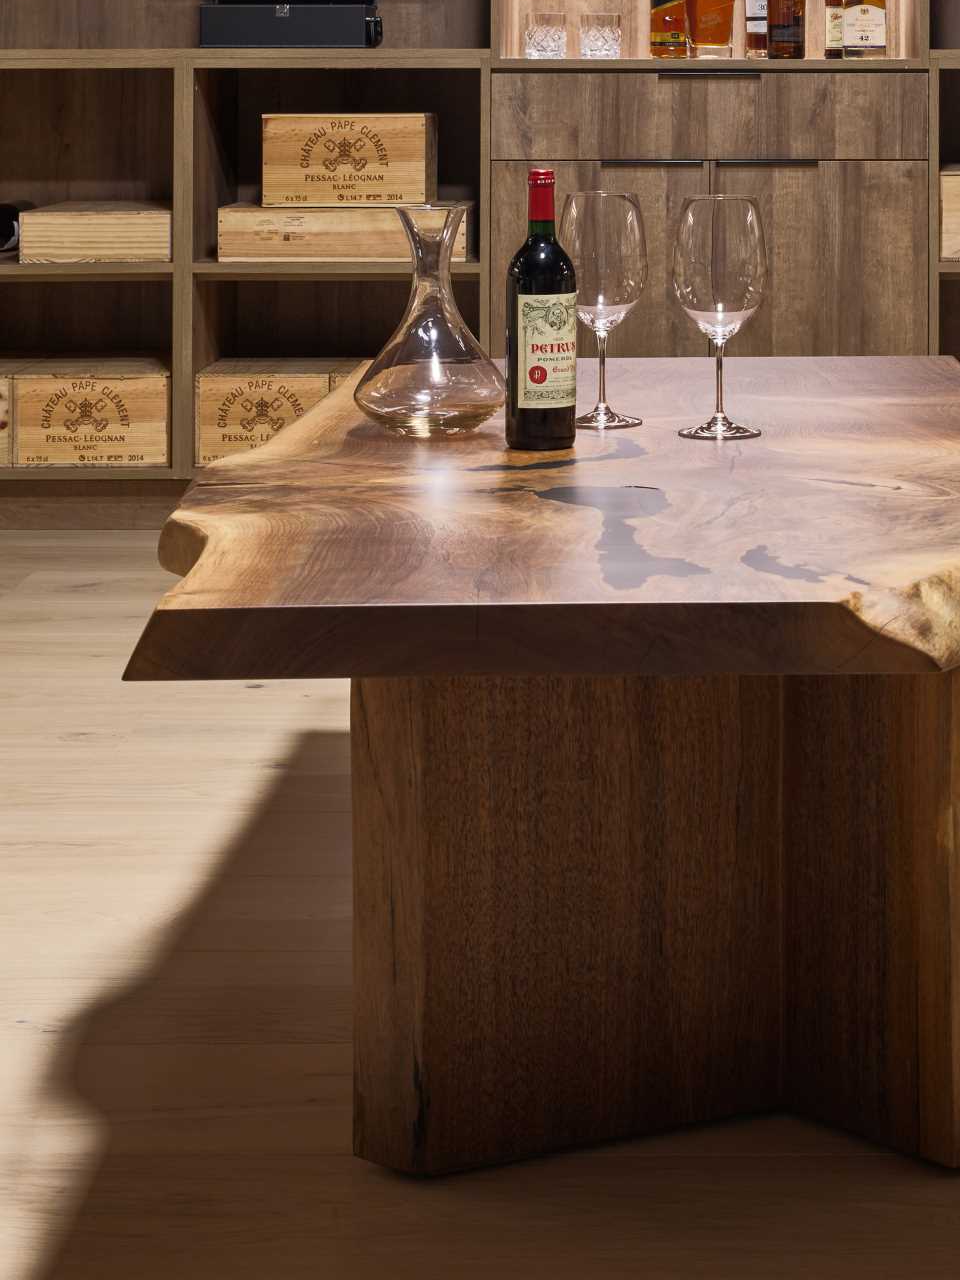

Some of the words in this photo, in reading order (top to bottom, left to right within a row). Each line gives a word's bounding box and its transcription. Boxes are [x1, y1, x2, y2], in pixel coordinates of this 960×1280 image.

[330, 119, 356, 131] PAPE
[387, 193, 403, 201] 2014
[72, 380, 97, 391] PAPE
[247, 380, 273, 391] PAPE
[277, 385, 305, 417] CLEME
